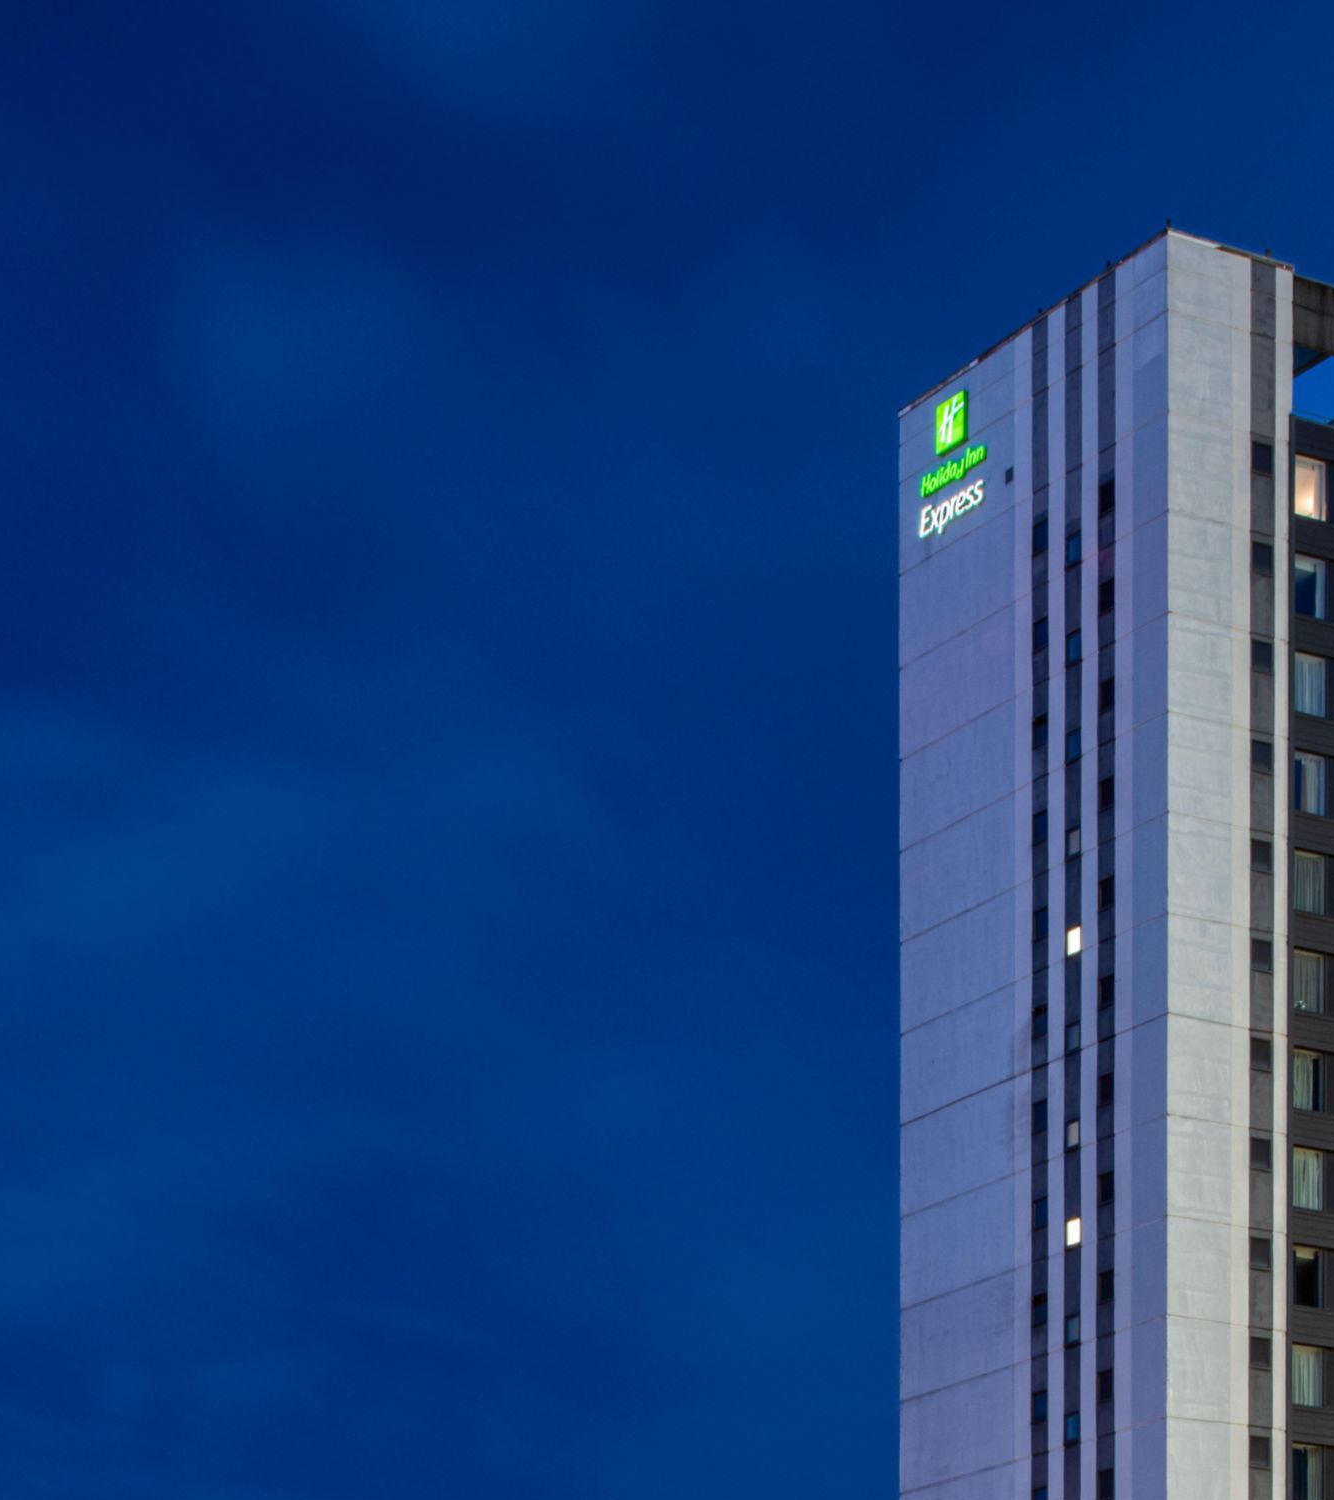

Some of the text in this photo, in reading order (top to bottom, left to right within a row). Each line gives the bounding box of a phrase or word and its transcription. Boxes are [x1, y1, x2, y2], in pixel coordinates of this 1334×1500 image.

[921, 446, 987, 497] Holiday Inn
[919, 479, 985, 539] Express
